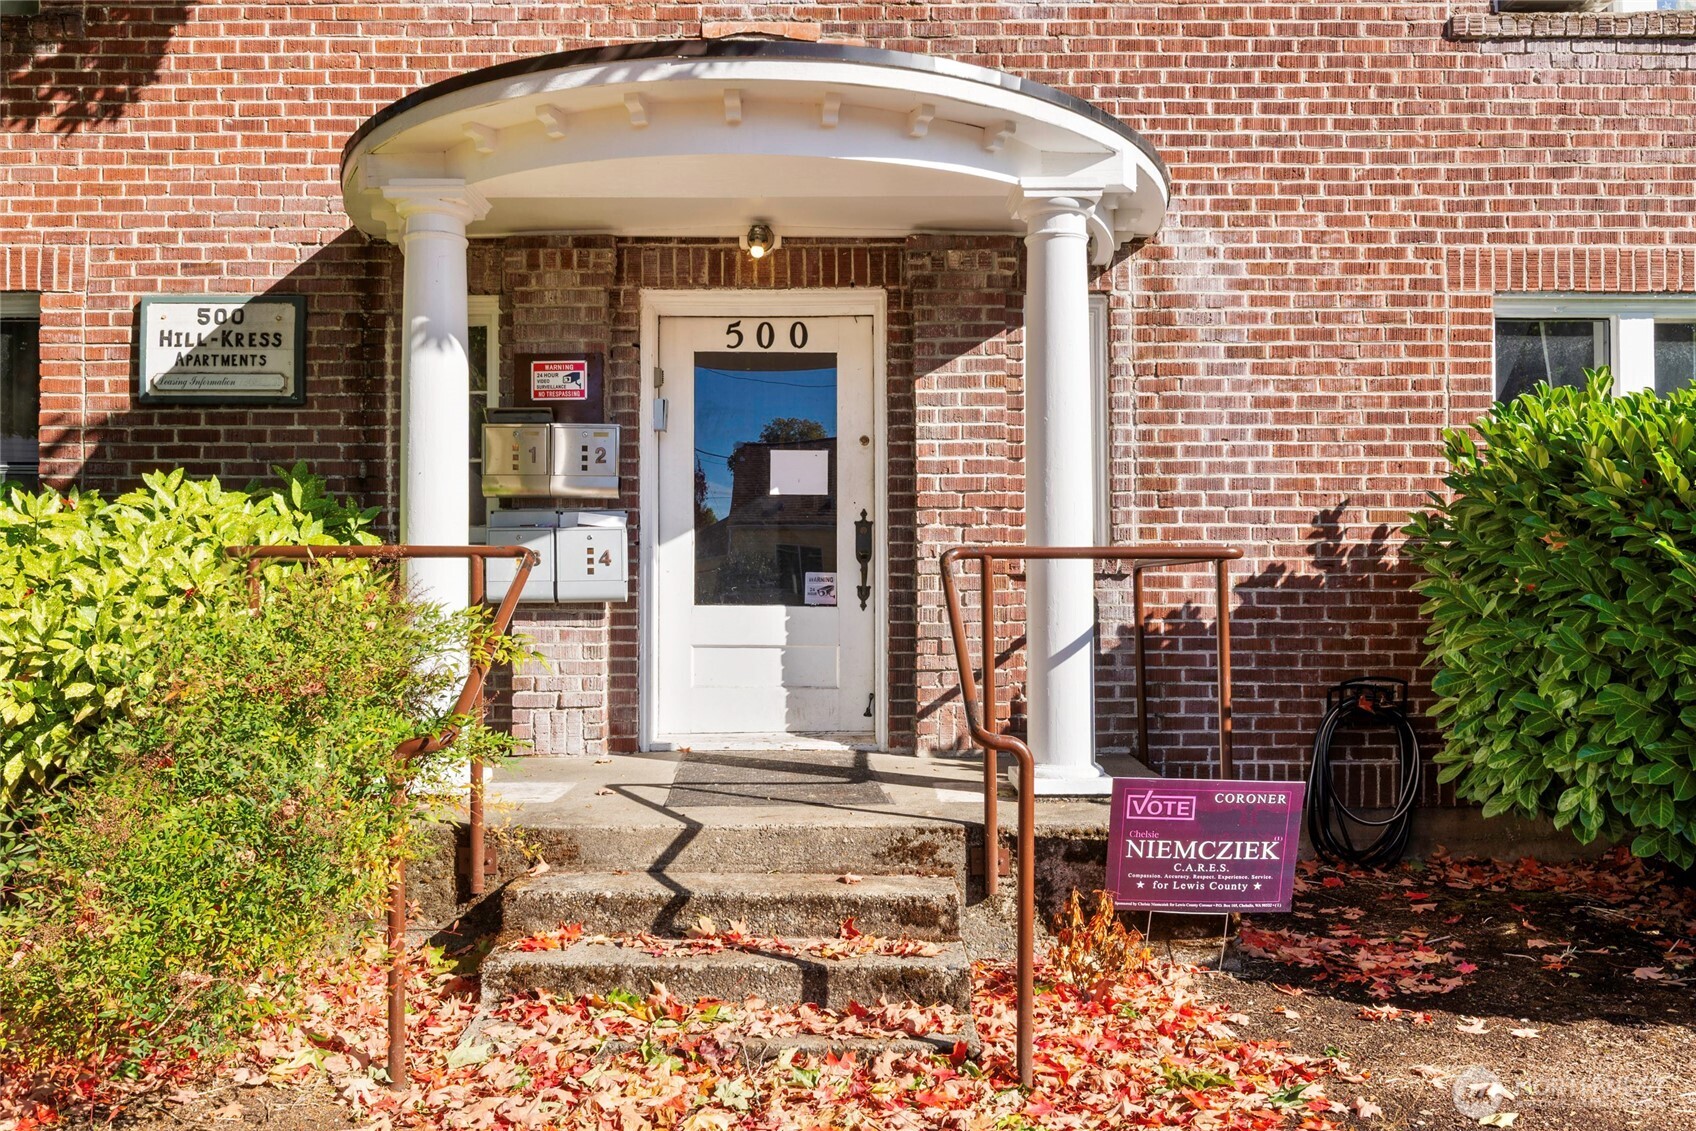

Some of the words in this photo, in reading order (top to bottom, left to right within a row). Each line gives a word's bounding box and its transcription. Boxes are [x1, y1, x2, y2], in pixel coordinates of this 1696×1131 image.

[197, 308, 245, 326] 500
[159, 329, 282, 348] HILL-KRESS
[725, 320, 809, 349] 500
[175, 352, 267, 367] APARTMENTS
[159, 376, 188, 389] Leasing
[189, 376, 236, 389] Information
[528, 446, 537, 464] 1
[594, 446, 607, 464] 2
[598, 549, 612, 567] 4
[1132, 791, 1190, 816] VOTE
[1214, 793, 1287, 804] CORONER
[1129, 830, 1160, 839] Chelsie
[1125, 839, 1280, 860] NIEMCZIEK
[1173, 863, 1230, 873] C.A.R.E.S.
[1152, 881, 1169, 889] for
[1172, 881, 1205, 890] Lewis
[1209, 882, 1249, 892] County
